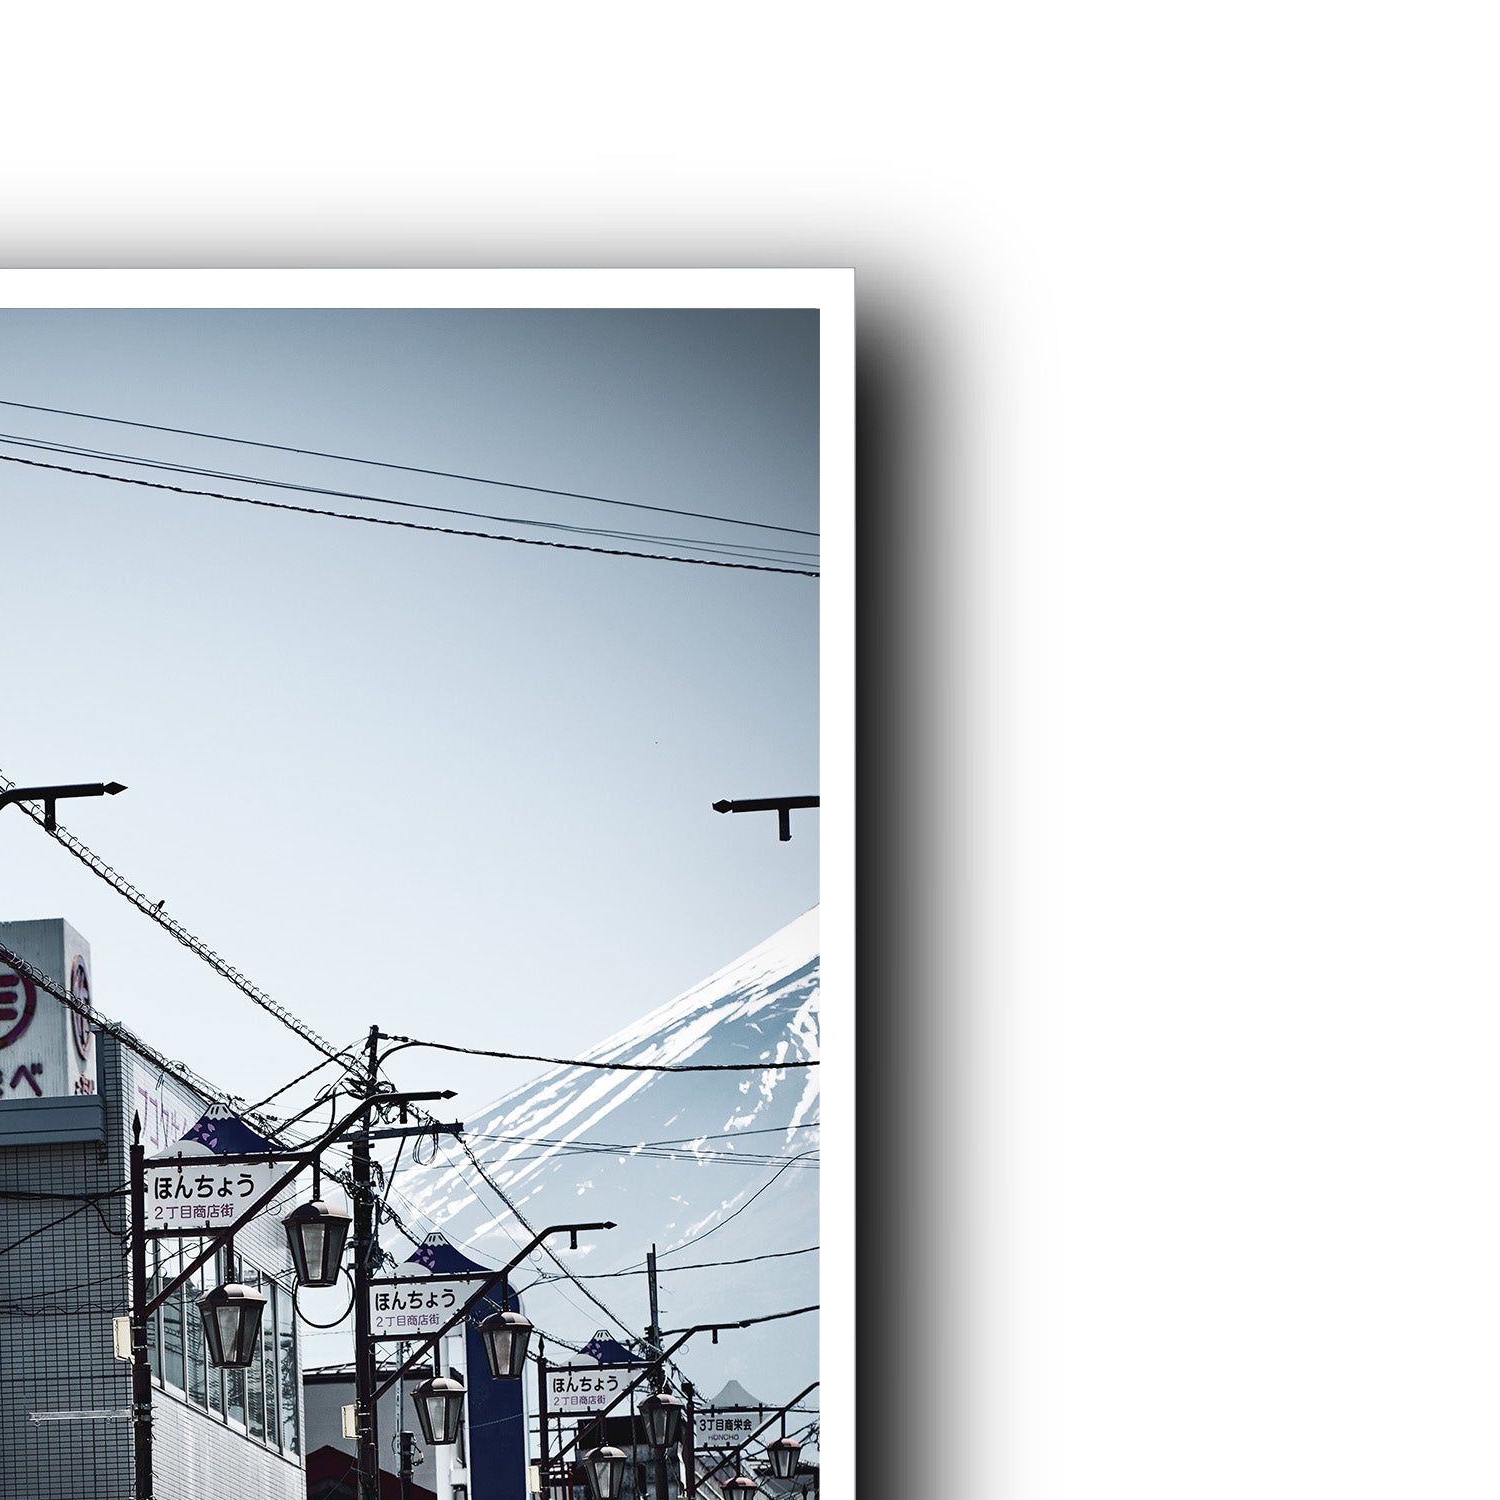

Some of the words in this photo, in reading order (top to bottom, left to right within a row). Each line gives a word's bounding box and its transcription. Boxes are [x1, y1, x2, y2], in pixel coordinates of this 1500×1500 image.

[154, 1173, 254, 1199] ほんちょう
[154, 1203, 234, 1219] 2丁目商店街
[375, 1288, 455, 1311] ほんちょう
[375, 1313, 440, 1327] 2丁目商店街
[553, 1375, 618, 1393] ほんちょう
[553, 1395, 606, 1406] 2丁目商店街
[699, 1418, 752, 1432] 3丁目商栄会
[708, 1433, 739, 1441] HONCHO
